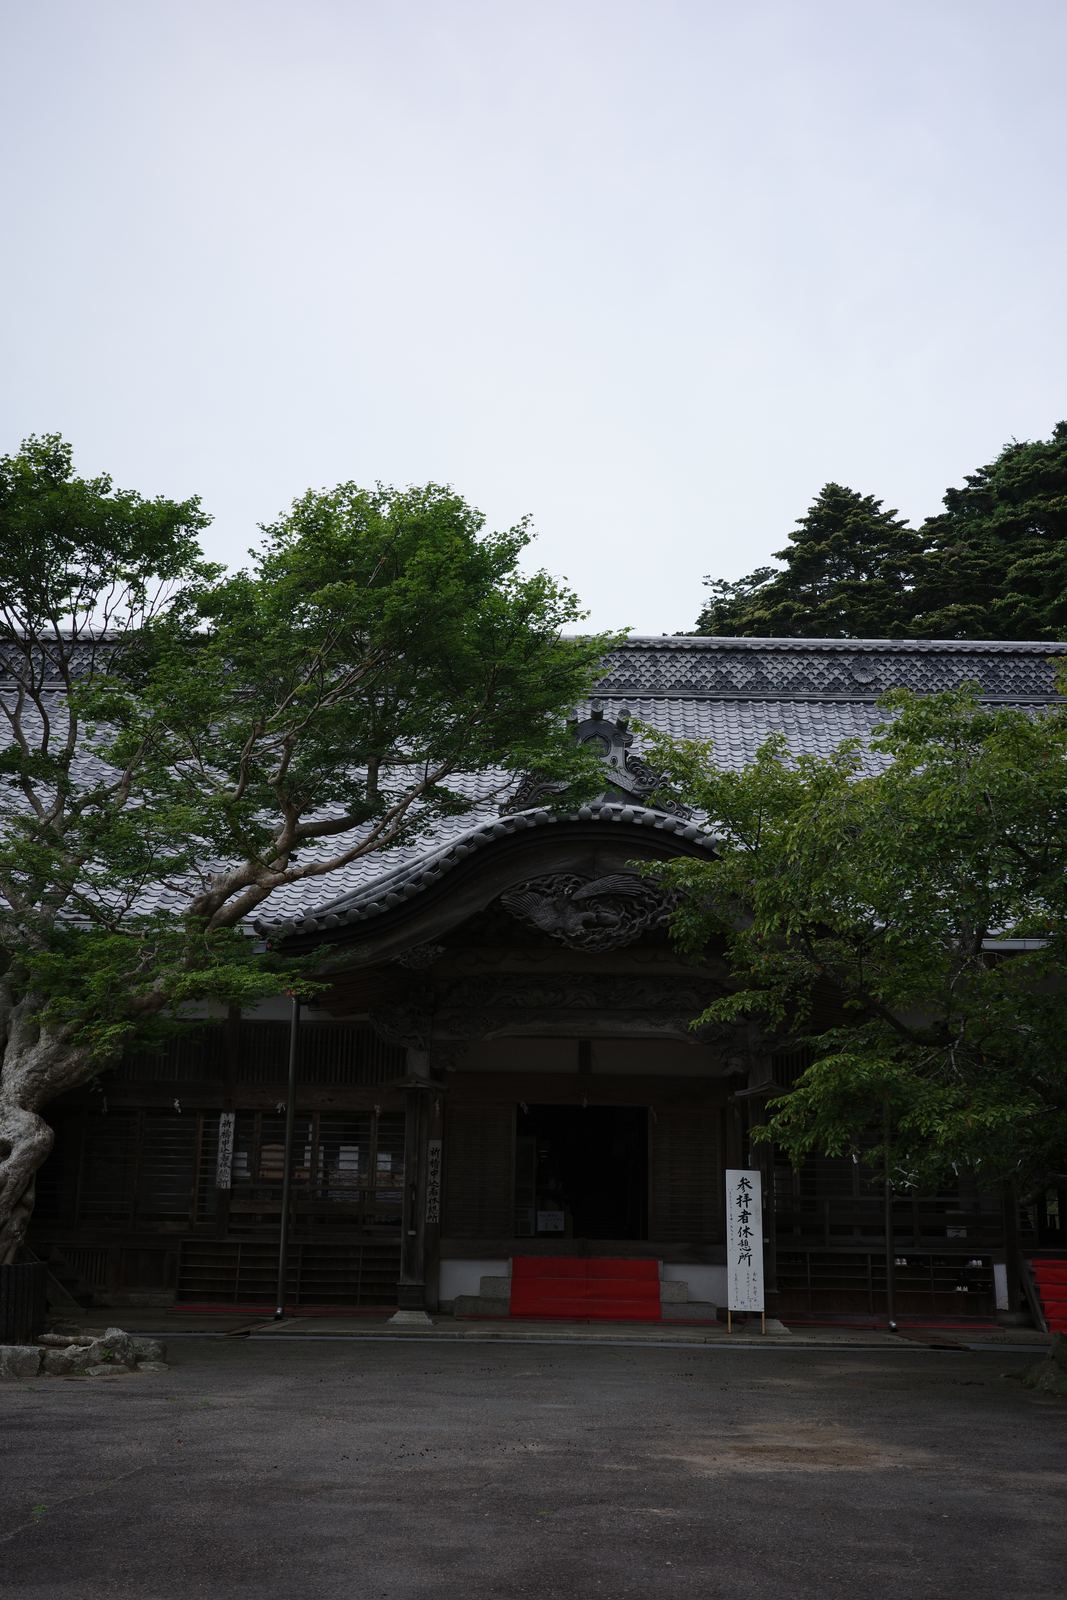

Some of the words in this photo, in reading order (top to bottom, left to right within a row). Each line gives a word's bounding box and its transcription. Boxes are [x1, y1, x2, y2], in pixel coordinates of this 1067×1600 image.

[736, 1176, 754, 1267] 参拝者休憩所
